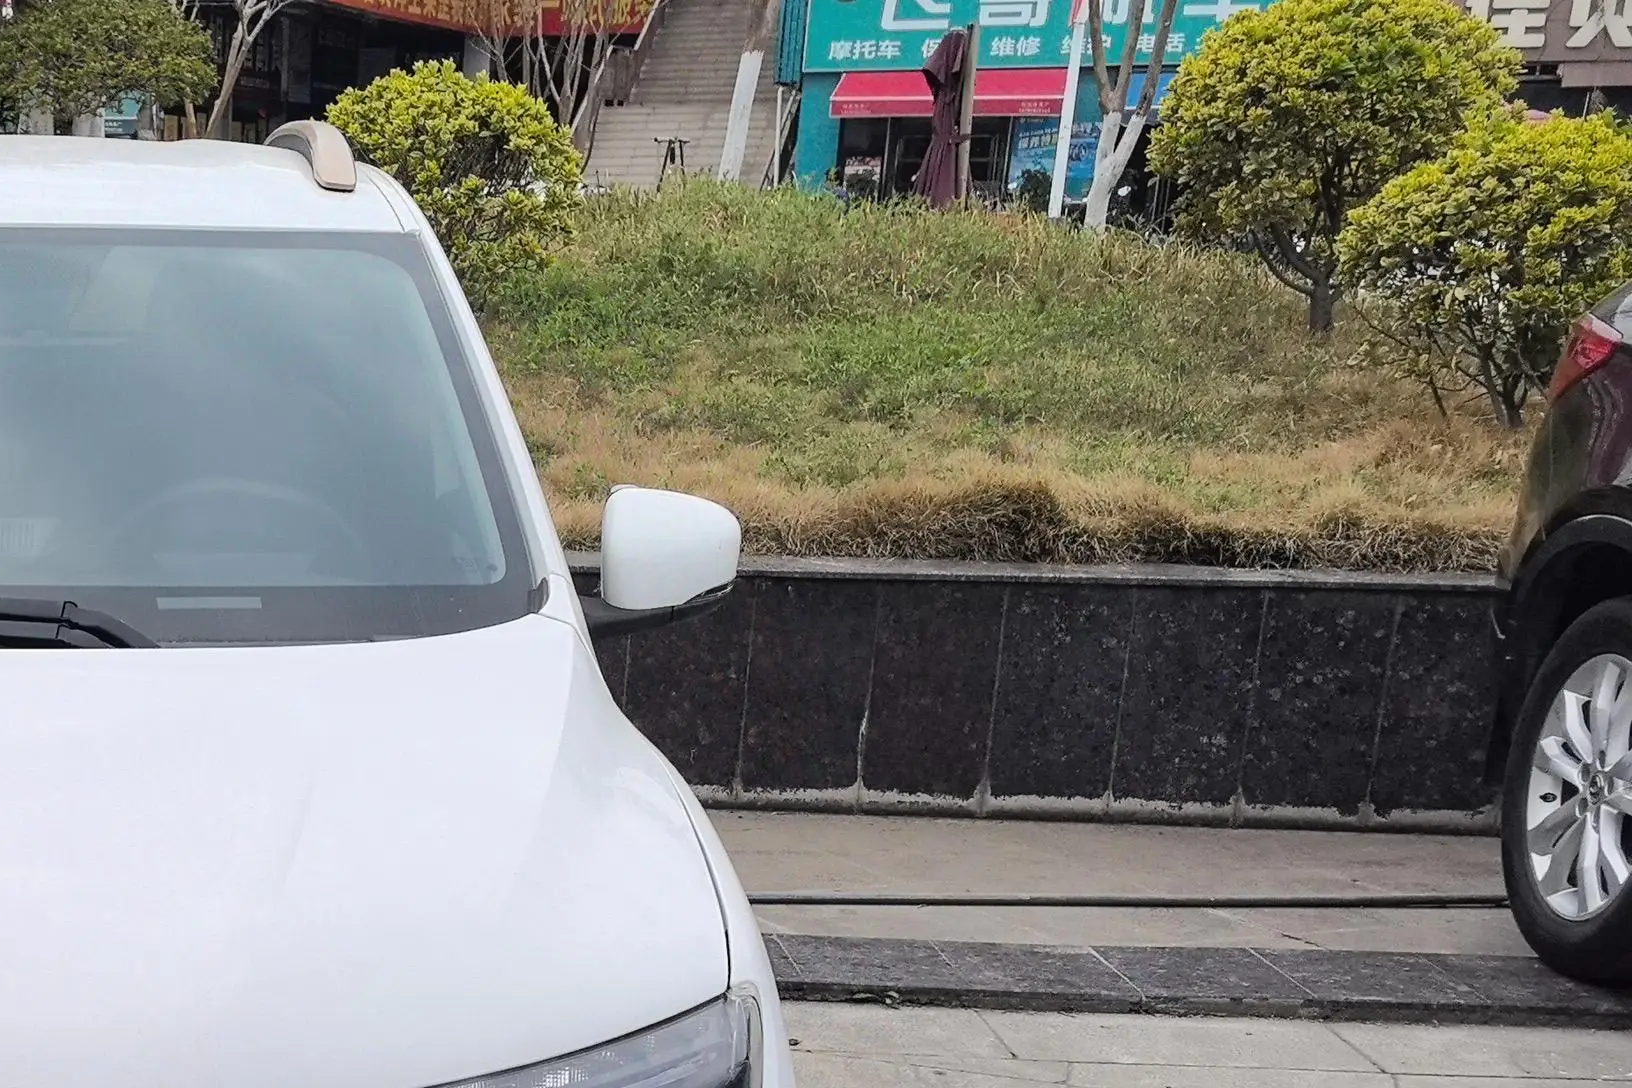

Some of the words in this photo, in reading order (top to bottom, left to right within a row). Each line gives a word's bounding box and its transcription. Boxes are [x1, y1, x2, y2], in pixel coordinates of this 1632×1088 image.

[828, 41, 901, 60] 摩托车
[991, 36, 1041, 57] 维修
